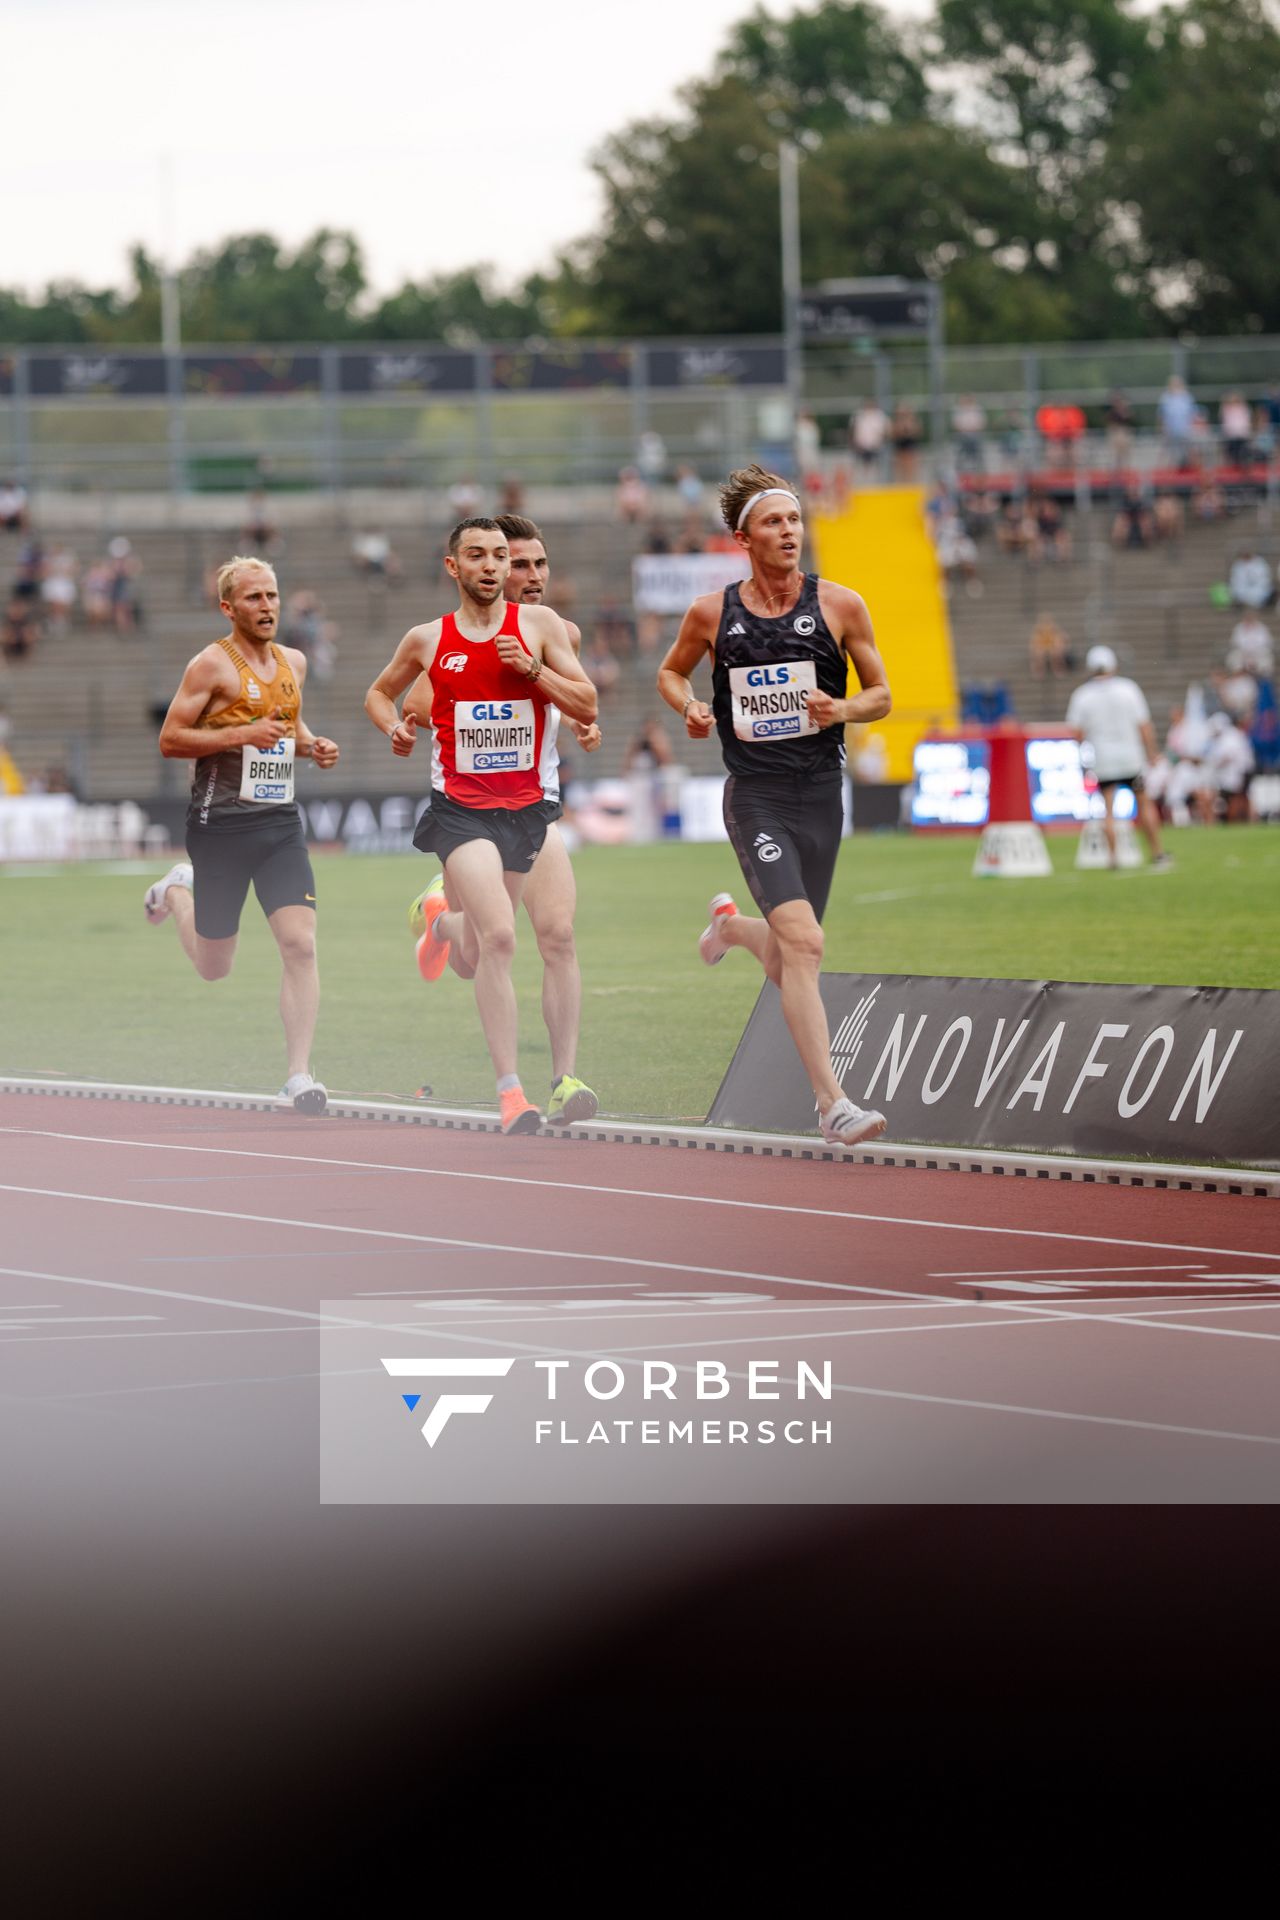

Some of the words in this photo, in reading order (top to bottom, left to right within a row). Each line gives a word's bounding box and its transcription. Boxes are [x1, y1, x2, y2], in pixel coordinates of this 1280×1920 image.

[740, 690, 809, 716] PARSONS
[771, 718, 799, 731] PLAN
[459, 726, 532, 748] THORWIRTH
[491, 754, 517, 764] PLAN
[249, 761, 292, 780] BREMM
[863, 1013, 1244, 1124] NOVAFON
